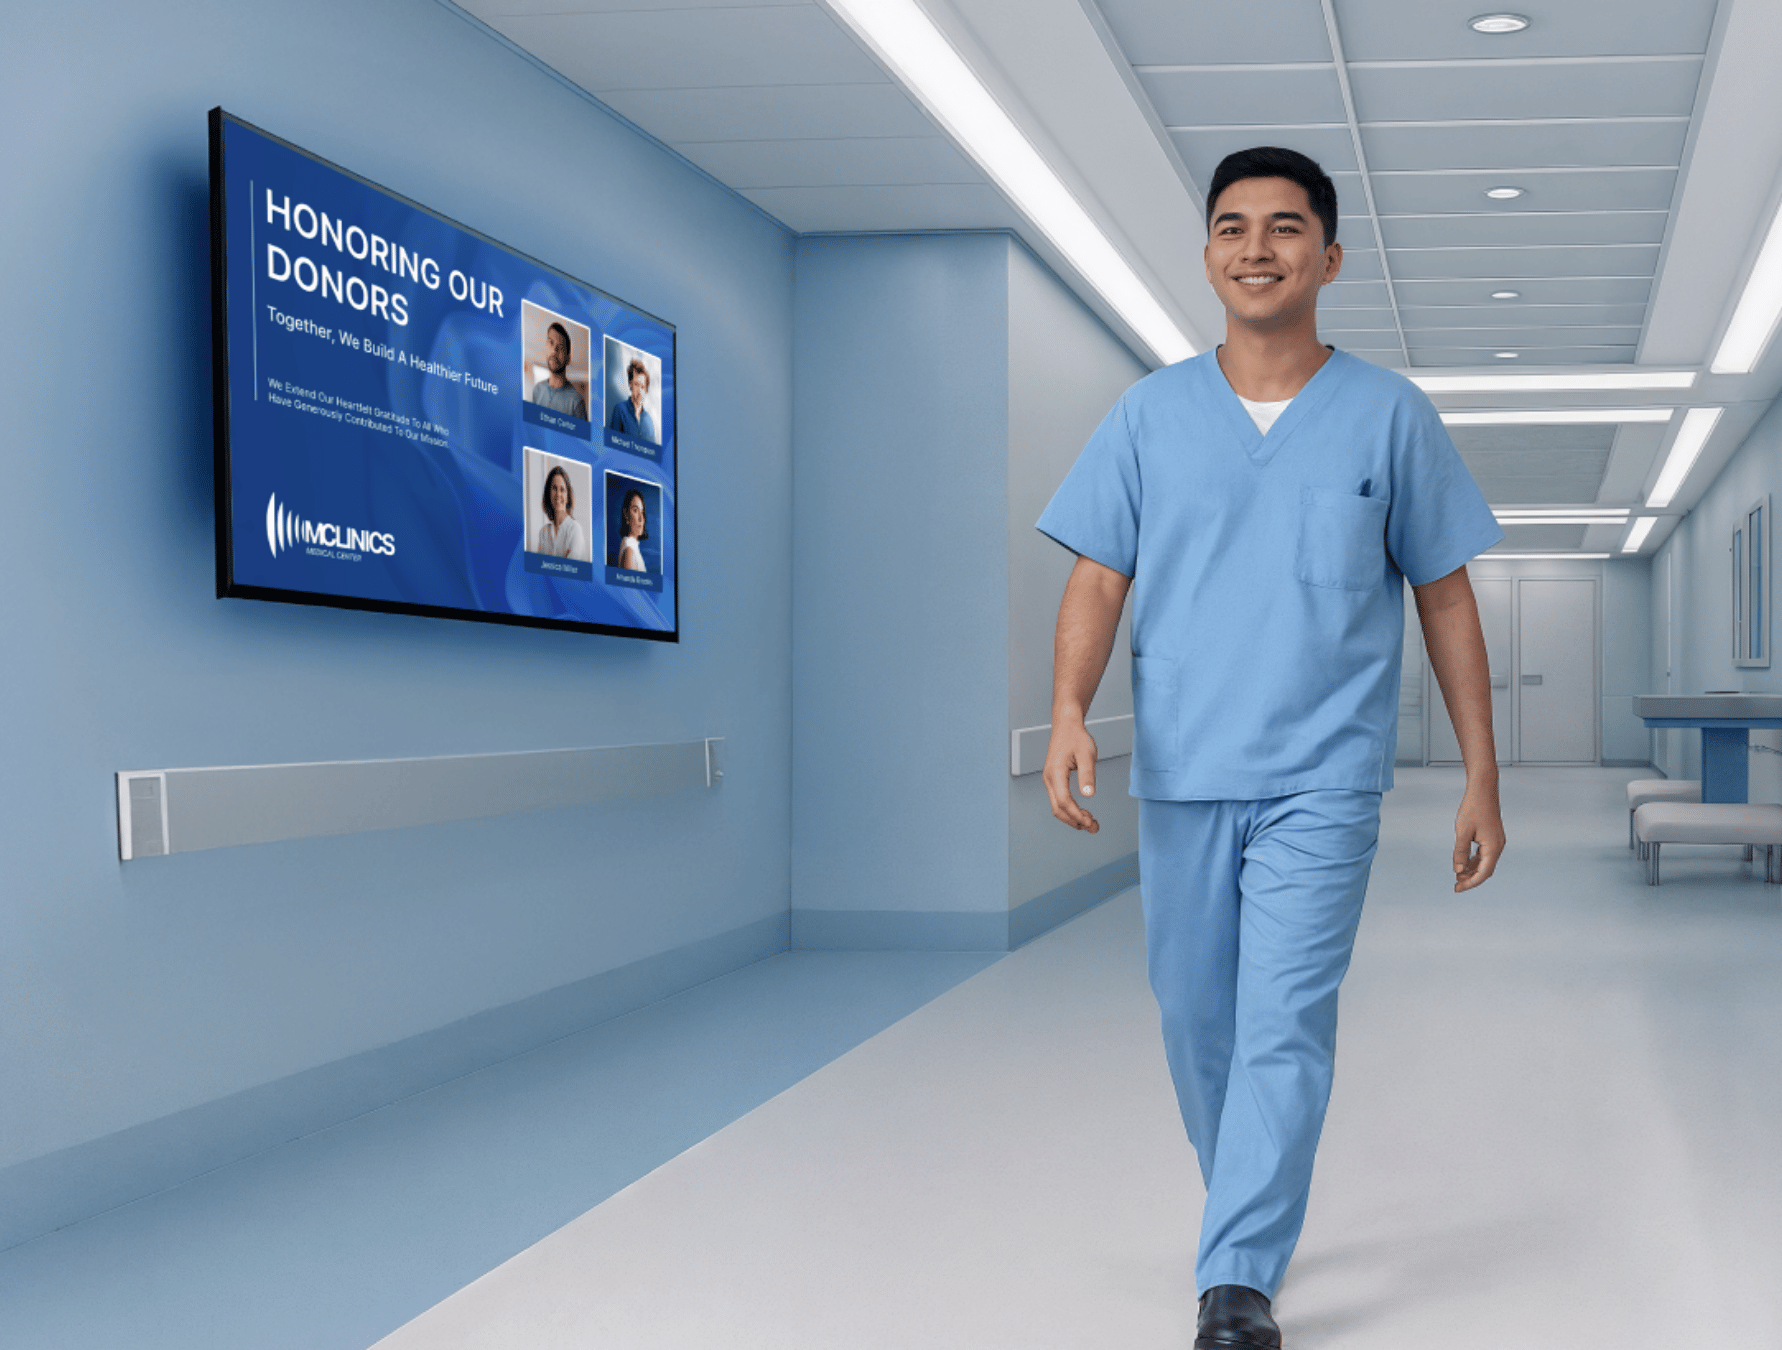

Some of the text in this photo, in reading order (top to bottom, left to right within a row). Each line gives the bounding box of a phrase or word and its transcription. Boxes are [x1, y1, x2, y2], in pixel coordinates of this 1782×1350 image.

[266, 188, 504, 318] HONORING OUR
[267, 243, 409, 326] DONORS
[266, 304, 499, 395] Together, We Build A Healthier Future
[267, 377, 450, 437] We Extend Our Heartfelt Gratitude To All Who
[268, 392, 292, 407] Have
[294, 400, 343, 422] Generously
[345, 413, 393, 434] Contributed
[394, 426, 403, 437] To
[405, 429, 419, 441] Our
[305, 547, 336, 559] MEDICAL
